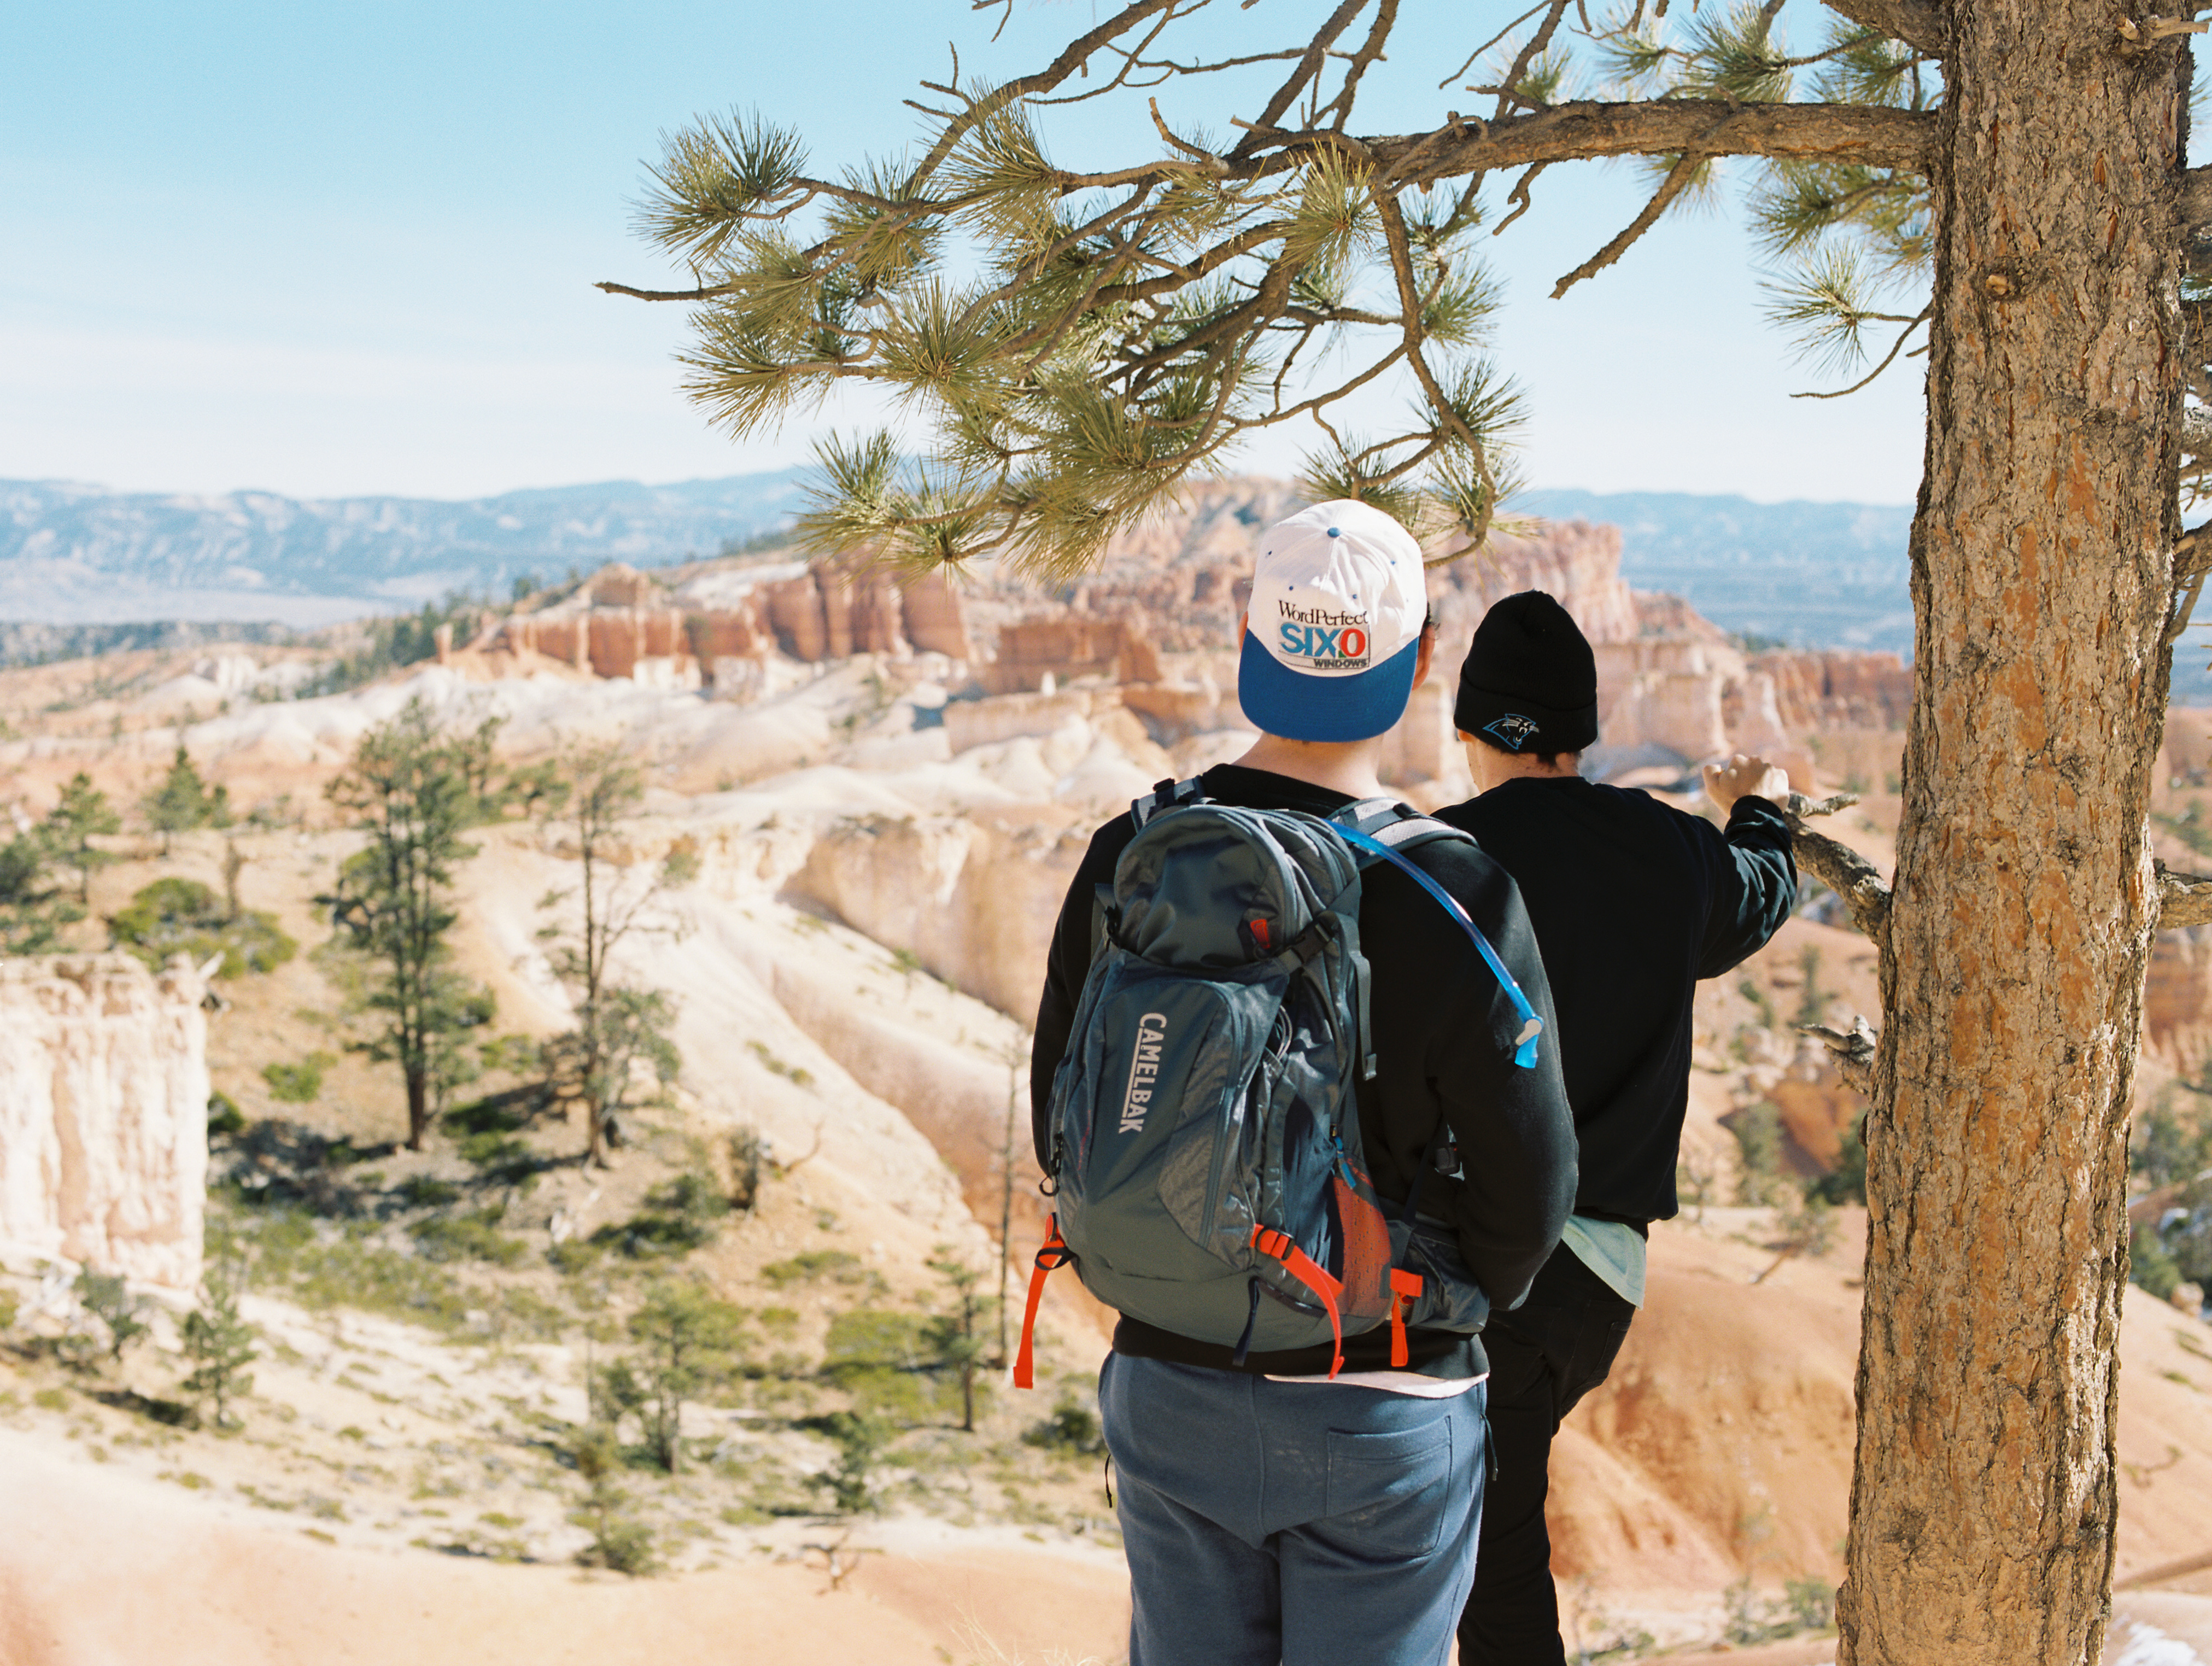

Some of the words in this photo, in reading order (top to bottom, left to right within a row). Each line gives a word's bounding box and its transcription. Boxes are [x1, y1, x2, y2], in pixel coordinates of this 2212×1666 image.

[1278, 600, 1368, 626] WordPerfect
[1313, 658, 1367, 668] WINDOWS
[1119, 1013, 1167, 1133] CAMELBAK
